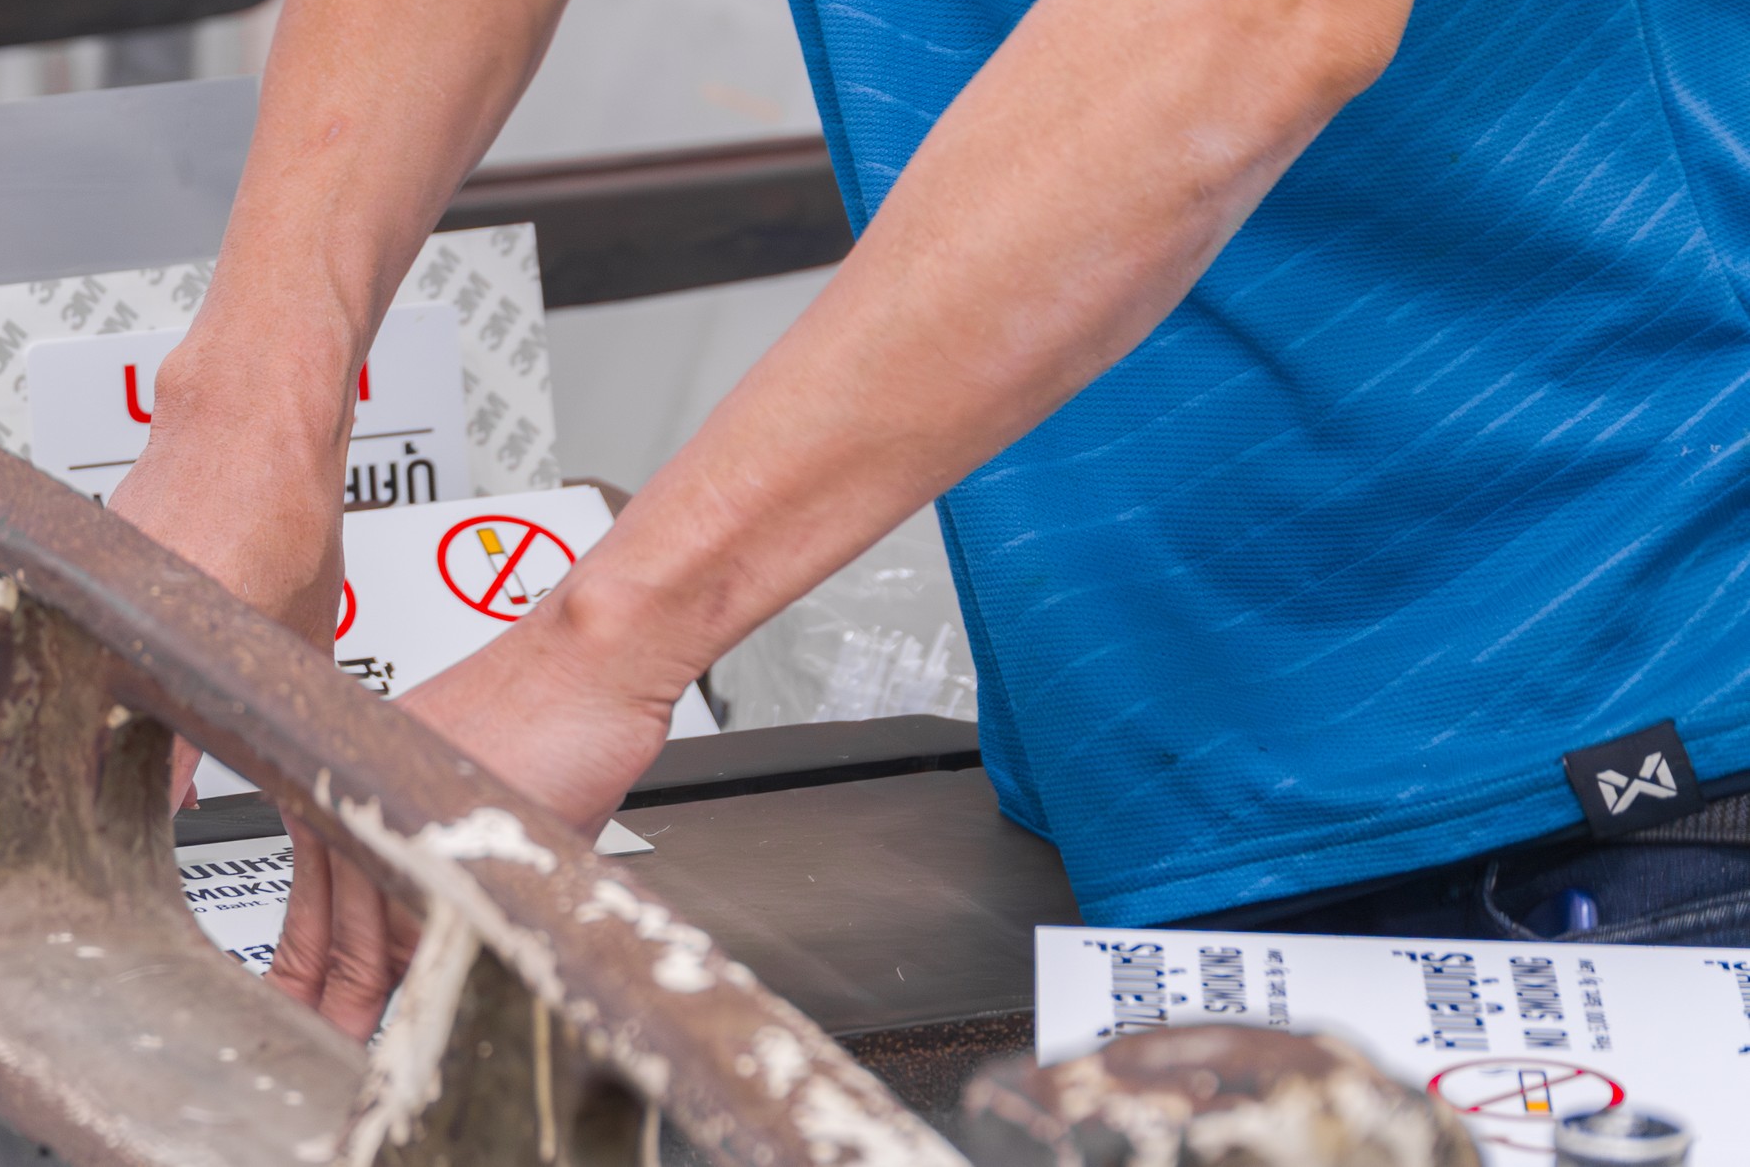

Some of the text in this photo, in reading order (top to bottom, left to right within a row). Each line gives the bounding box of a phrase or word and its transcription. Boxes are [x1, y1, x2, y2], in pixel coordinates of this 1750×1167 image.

[418, 244, 462, 300] 3M
[61, 275, 107, 331] 3M
[479, 294, 522, 352] 3M
[466, 391, 510, 446] 3M
[497, 415, 541, 471] 3M
[1199, 946, 1248, 1014] SMOKING
[1509, 955, 1571, 1051] NO SMOKING
